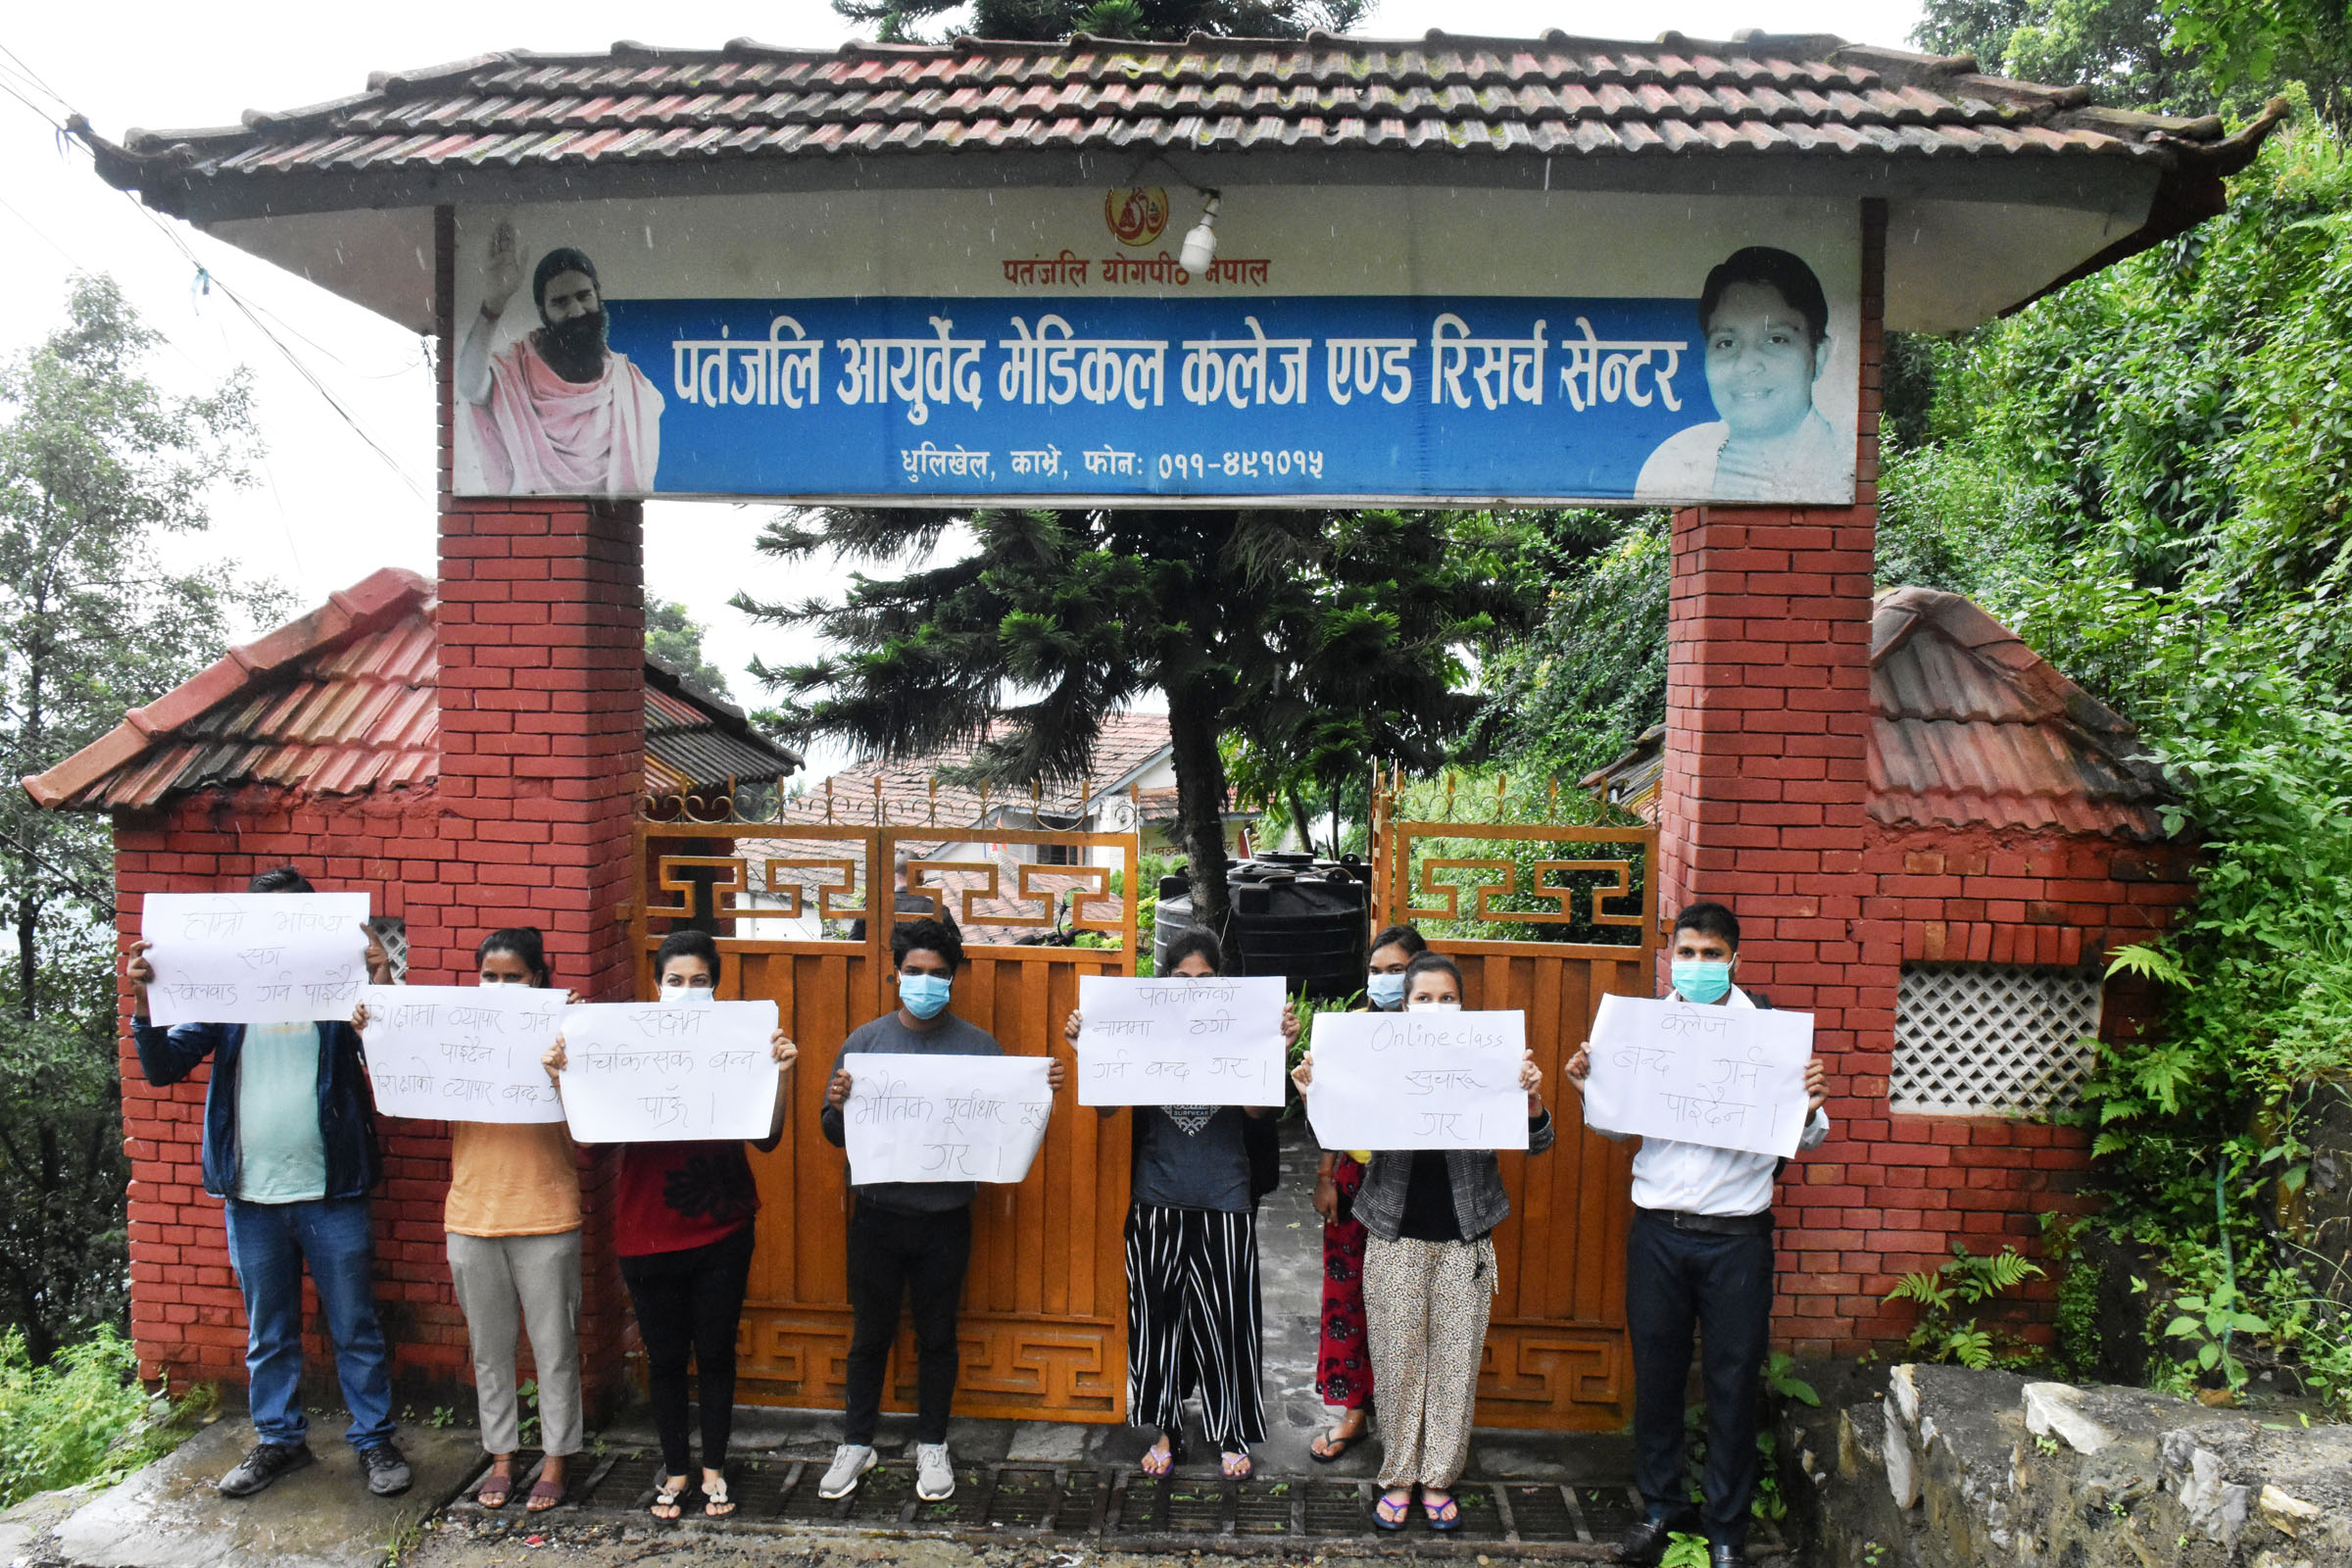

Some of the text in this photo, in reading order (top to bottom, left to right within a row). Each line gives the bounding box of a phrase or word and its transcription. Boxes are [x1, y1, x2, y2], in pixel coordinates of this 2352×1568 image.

[1003, 250, 1090, 287] पतंजलि
[673, 313, 1688, 425] पतंजलि आयुर्वेद मेडिकल कलेज एण्ड रिसर्च सेन्टर
[1372, 1019, 1505, 1052] Online class
